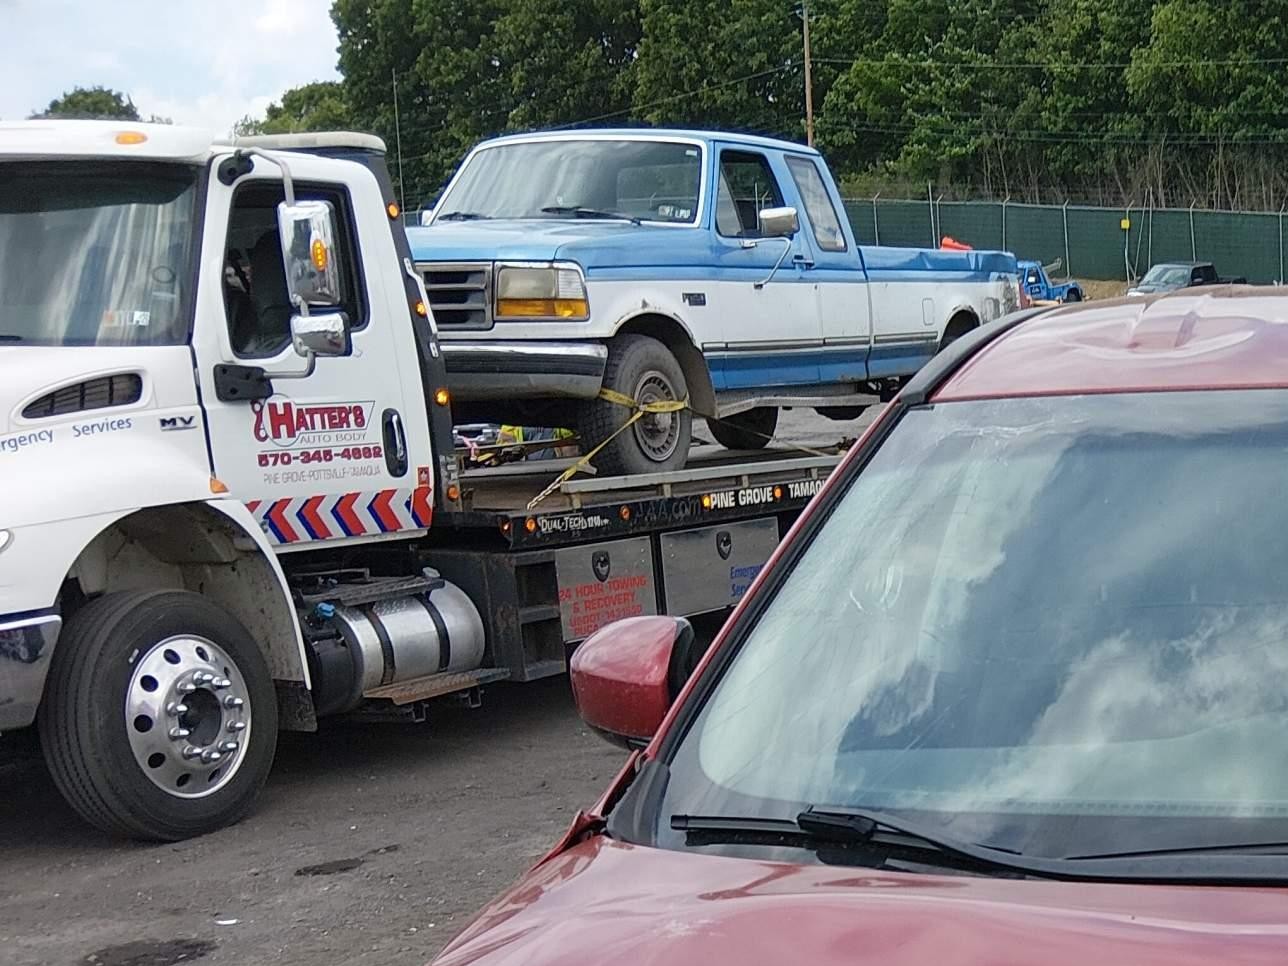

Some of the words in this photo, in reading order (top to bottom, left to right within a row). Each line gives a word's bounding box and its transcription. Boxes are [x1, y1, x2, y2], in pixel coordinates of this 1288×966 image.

[72, 417, 132, 438] Services
[159, 415, 196, 428] MV
[267, 402, 366, 439] HATTER'S
[300, 433, 332, 444] AUTO
[335, 431, 368, 442] BODY
[710, 491, 736, 510] PINE
[738, 486, 774, 506] GROVE
[560, 587, 572, 601] 24
[575, 581, 604, 598] HOUR
[607, 575, 647, 592] TOWING
[584, 591, 636, 611] RECOVERY
